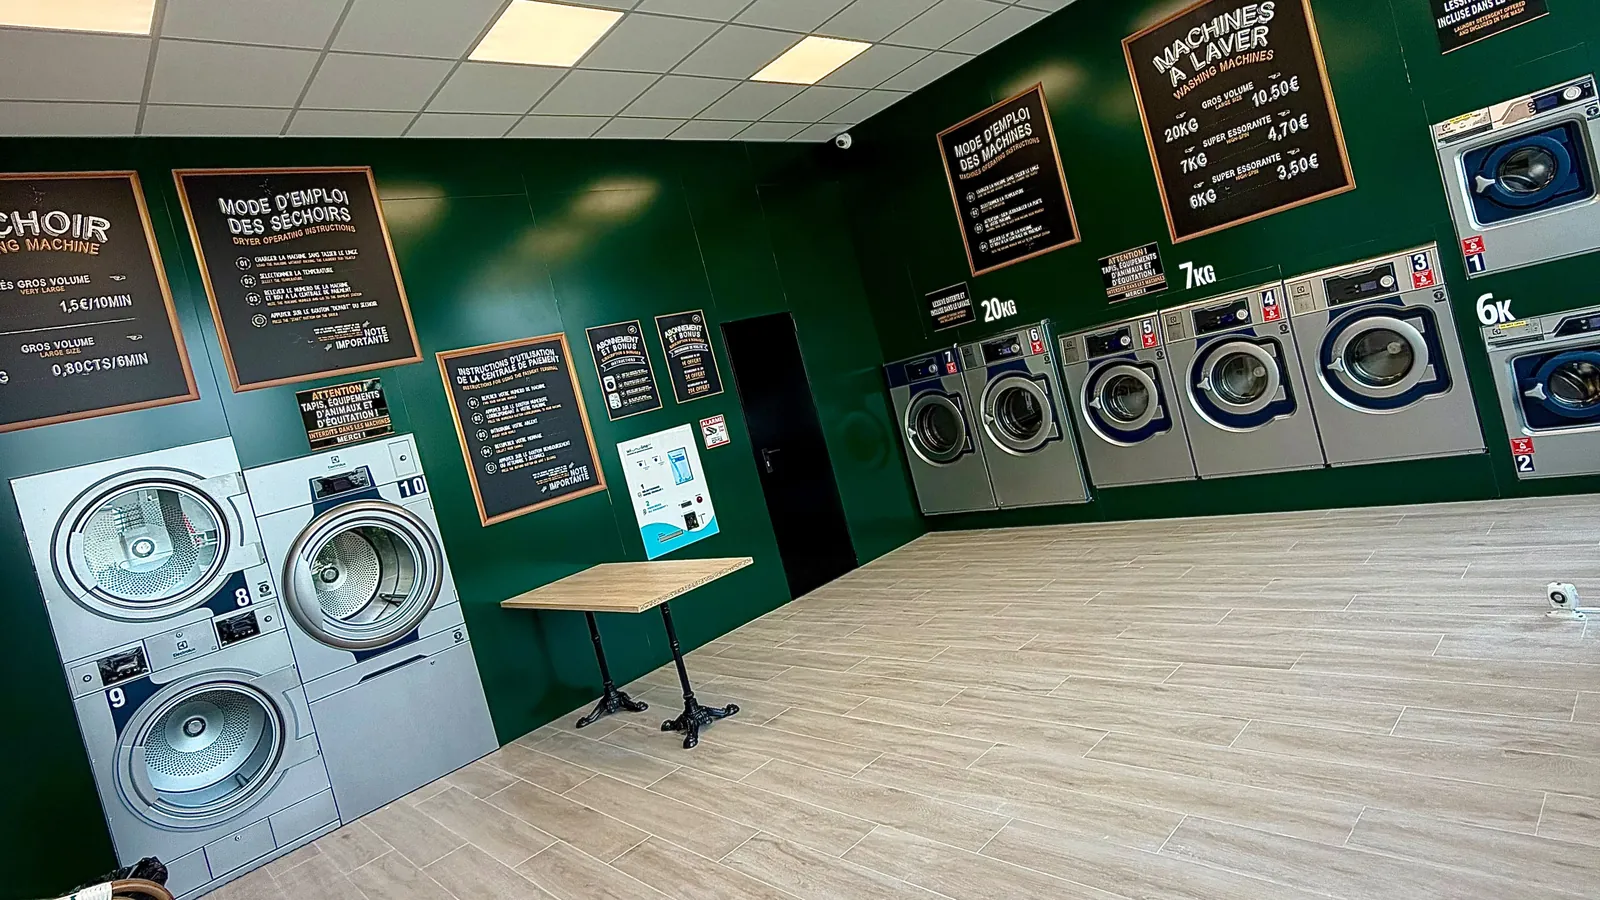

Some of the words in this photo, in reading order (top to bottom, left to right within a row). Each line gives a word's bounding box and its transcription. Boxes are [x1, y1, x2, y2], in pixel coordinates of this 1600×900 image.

[1438, 8, 1471, 28] INCLUSE
[1471, 0, 1494, 16] DANS
[1152, 1, 1276, 74] MACHINES
[1190, 25, 1269, 71] LAVER
[1173, 67, 1217, 100] WASHING
[1219, 50, 1274, 73] MACHINES
[1202, 95, 1222, 110] GROS
[1224, 82, 1254, 101] VOLUME
[954, 135, 982, 158] MODE
[984, 107, 1031, 143] D'EMPLOI
[1164, 117, 1199, 144] 20KG
[1203, 133, 1226, 148] SUPER
[1227, 115, 1272, 139] ESSORANTE
[1268, 113, 1309, 142] 4,70€
[960, 154, 980, 172] DES
[981, 123, 1032, 162] MACHINES
[1006, 137, 1040, 155] INSTRUCTIONS
[1180, 152, 1208, 174] 7KG
[1212, 169, 1236, 184] SUPER
[1237, 153, 1282, 175] ESSORANTE
[1276, 153, 1319, 180] 3,50€
[218, 198, 272, 216] MODE
[274, 188, 350, 211] D'EMPLOI
[1189, 189, 1217, 210] 6KG
[227, 217, 265, 235] DES
[270, 206, 352, 232] SÉCHOIRS
[232, 236, 262, 246] DRYER
[263, 229, 304, 244] OPERATING
[305, 223, 356, 235] INSTRUCTIONS
[25, 238, 100, 255] MACHINE
[1108, 249, 1144, 265] ATTENTION
[1414, 254, 1427, 270] 3
[1470, 255, 1481, 271] 1
[1111, 264, 1144, 279] D'ANIMAUX
[1144, 262, 1152, 270] ET
[1179, 261, 1217, 290] 7KG
[17, 279, 47, 289] GROS
[50, 275, 90, 286] VOLUME
[20, 287, 39, 295] VERY
[41, 286, 66, 294] LARGE
[1125, 289, 1142, 298] MERCI
[1264, 292, 1274, 305] 4
[59, 294, 133, 315] 1,5€/10MIN
[981, 297, 1017, 322] 20KG
[1476, 293, 1516, 325] 6K
[364, 327, 388, 337] NOTE
[664, 324, 702, 338] ABONNEMENT
[1030, 328, 1038, 341] 6
[1143, 320, 1152, 333] 5
[21, 342, 51, 353] GROS
[53, 337, 95, 350] VOLUME
[336, 334, 390, 349] IMPORTANTE
[596, 336, 639, 351] ABONNEMENT
[669, 335, 677, 343] ET
[679, 331, 701, 339] BONUS
[40, 349, 64, 358] LARGE
[66, 348, 82, 356] SIZE
[601, 347, 610, 356] ET
[612, 343, 637, 352] BONUS
[945, 351, 951, 362] 7
[52, 352, 149, 378] 0,80CTS/6MIN
[456, 376, 468, 384] DE
[469, 375, 480, 384] LA
[482, 365, 517, 381] CENTRALE
[518, 362, 527, 370] DE
[528, 355, 560, 368] PAIEMENT
[458, 358, 509, 376] INSTRUCTIONS
[510, 348, 555, 364] D'UTILISATION
[301, 401, 328, 412] TAPIS,
[328, 390, 380, 408] ÉQUIPEMENTS
[312, 385, 362, 401] ATTENTION
[363, 383, 367, 392] !
[316, 402, 362, 419] D'ANIMAUX
[364, 400, 373, 409] ET
[317, 410, 375, 428] D'ÉQUITATION
[375, 409, 379, 417] !
[309, 428, 338, 439] INTERDITS
[340, 426, 354, 434] DANS
[365, 417, 391, 428] MACHINES
[337, 434, 361, 443] MERCI
[570, 465, 588, 475] NOTE
[1518, 455, 1532, 472] 2
[400, 478, 424, 497] 10
[549, 473, 590, 490] IMPORTANTE
[235, 588, 249, 607] 8
[108, 687, 126, 708] 9
